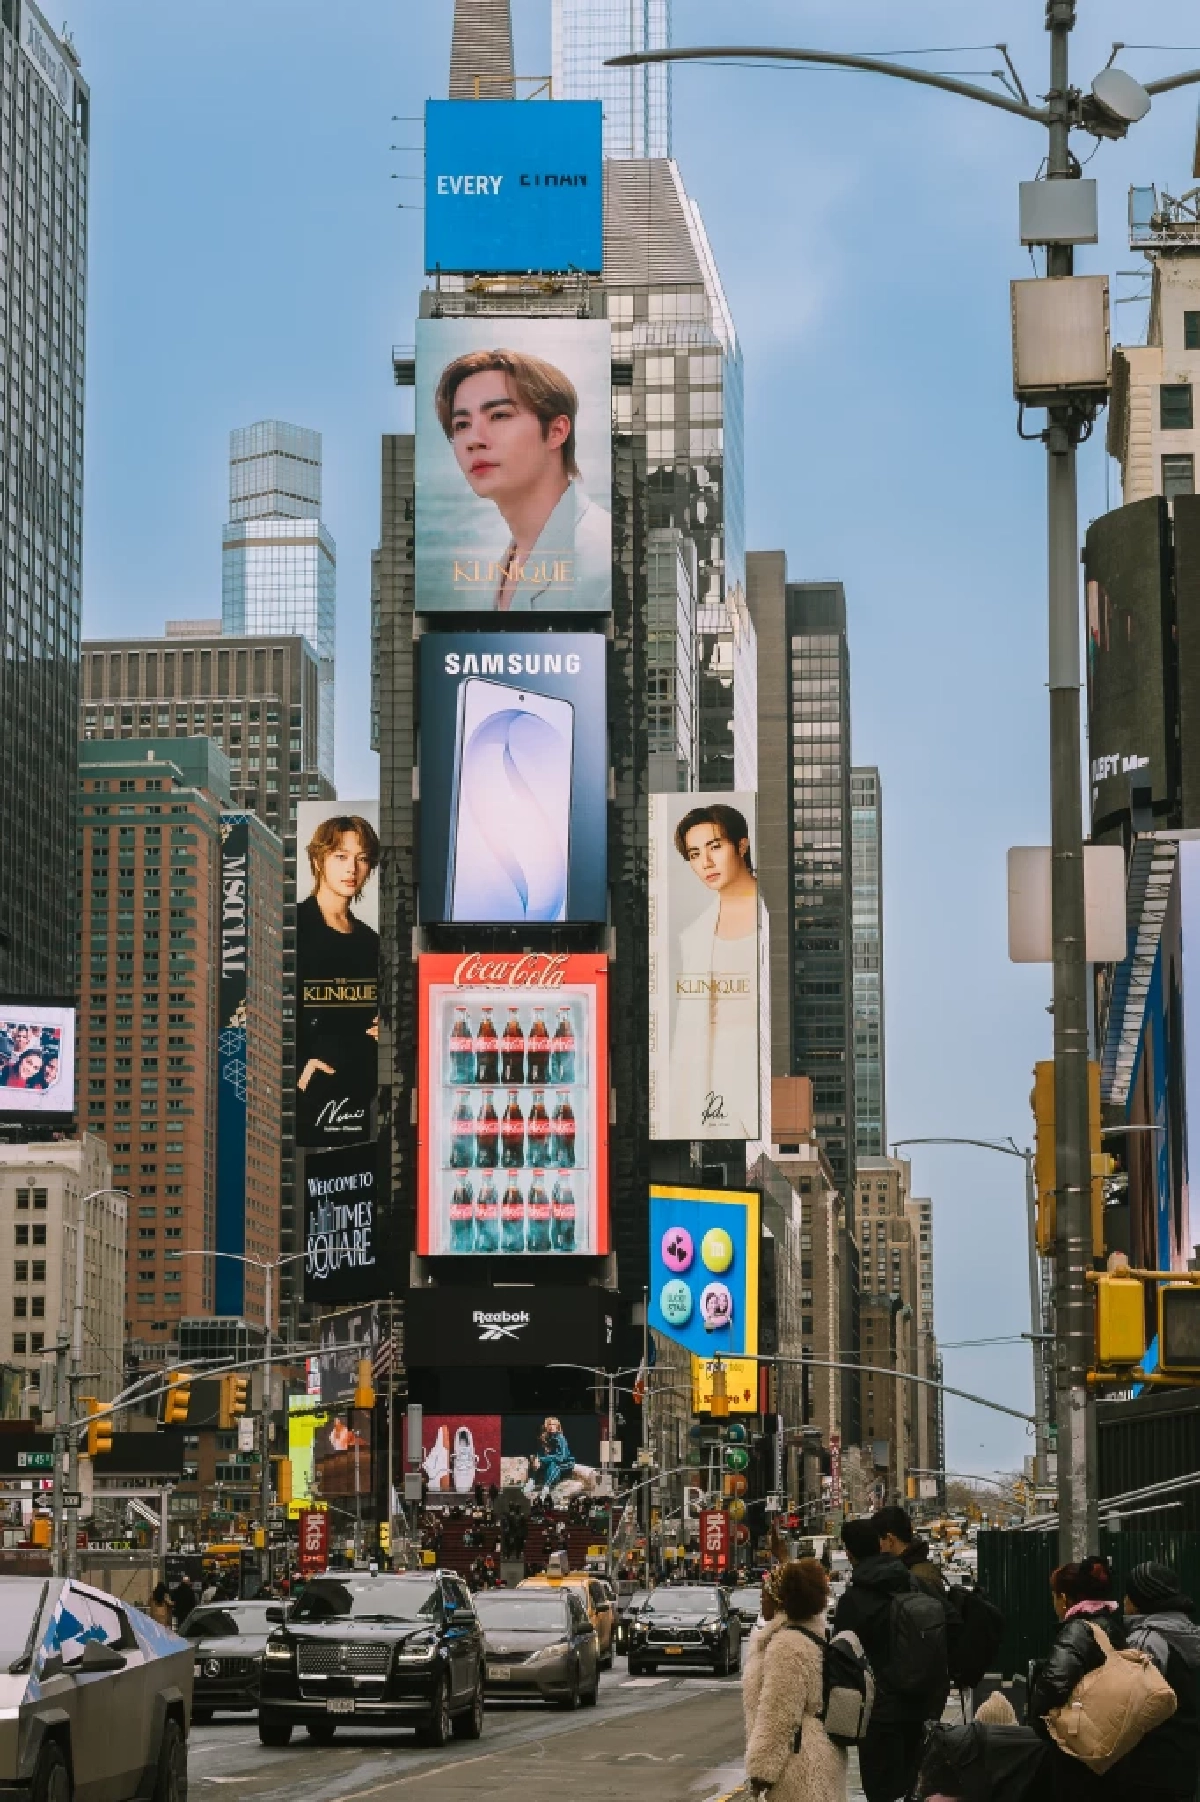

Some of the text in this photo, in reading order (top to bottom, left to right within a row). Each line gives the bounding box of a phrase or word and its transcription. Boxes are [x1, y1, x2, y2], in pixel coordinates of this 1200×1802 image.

[437, 175, 504, 195] EVERY
[453, 560, 575, 583] KLINIQUE
[444, 652, 582, 675] SAMSUNG
[453, 952, 571, 989] Coca-Cola
[303, 984, 378, 1001] KLINIQUE
[676, 979, 751, 994] KLINIQUE
[307, 1171, 374, 1198] WELCOME TO
[332, 1201, 373, 1231] TIMES
[472, 1310, 531, 1323] Reebok
[305, 1512, 325, 1551] tkts
[706, 1512, 726, 1551] tkts
